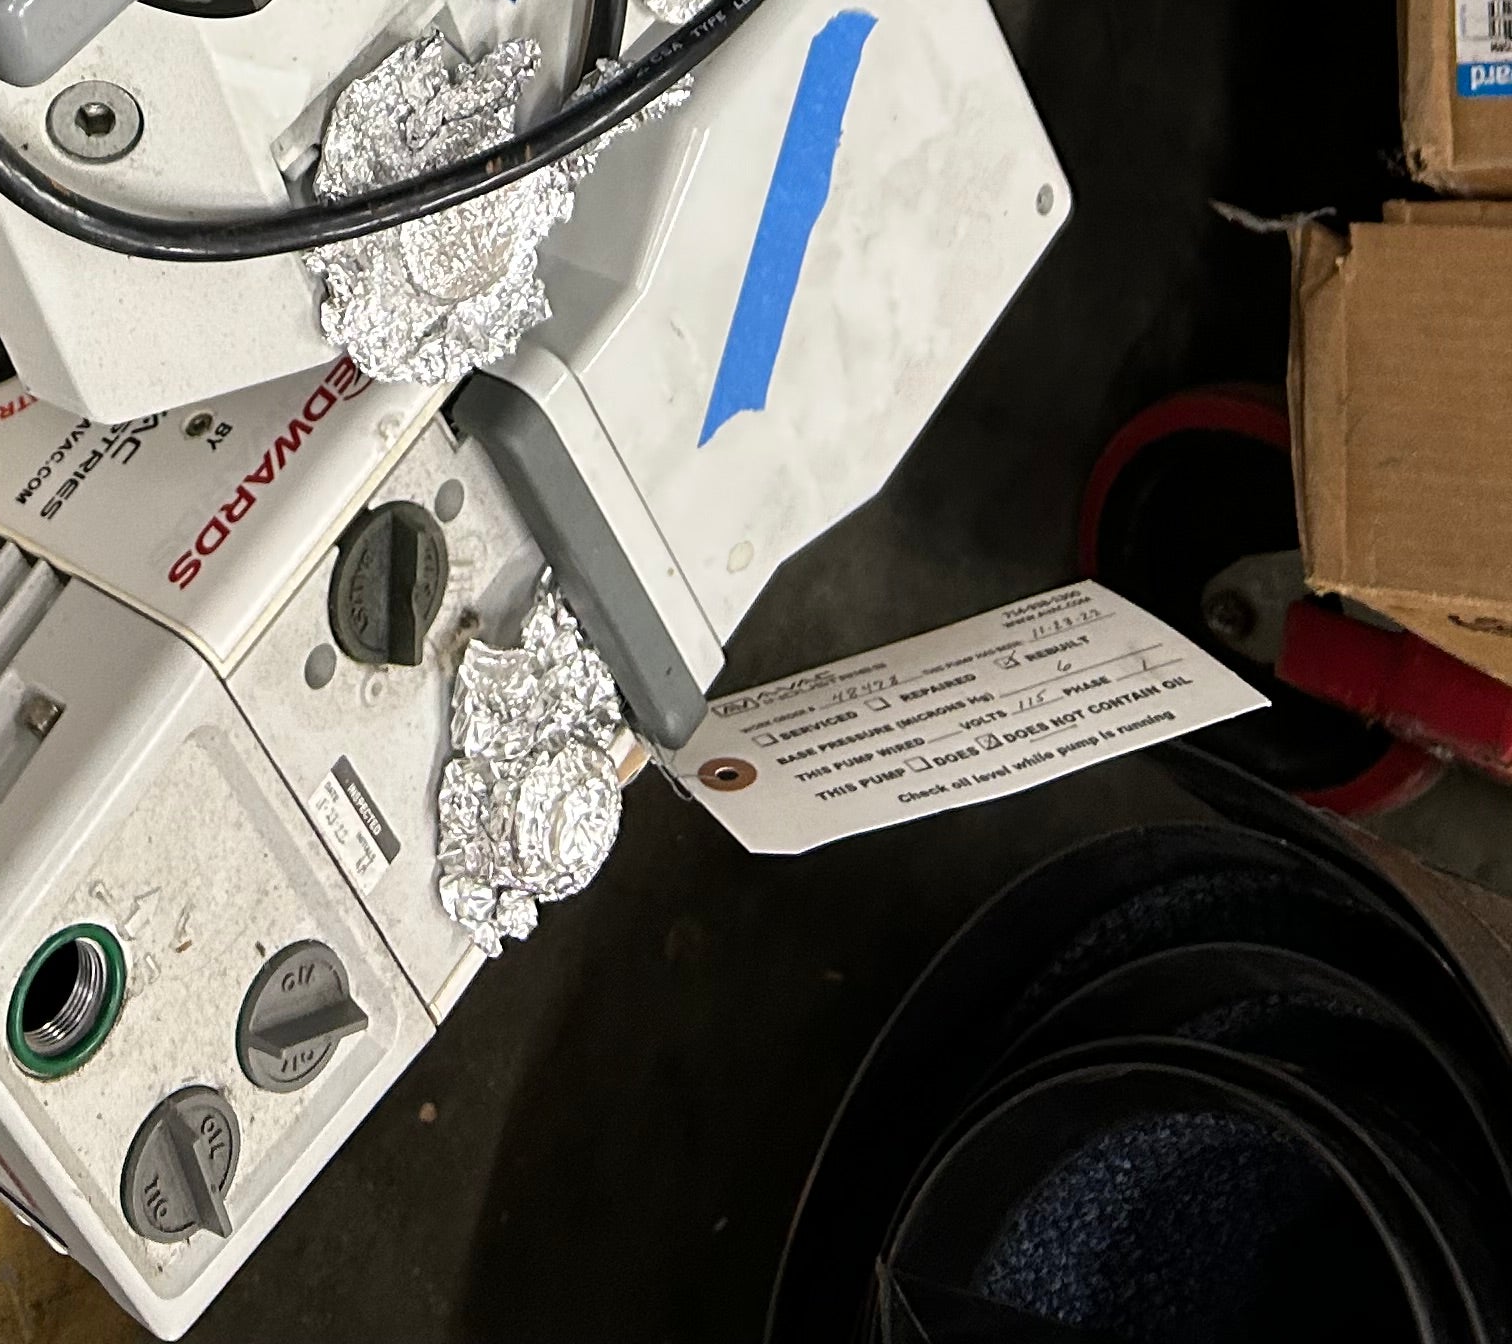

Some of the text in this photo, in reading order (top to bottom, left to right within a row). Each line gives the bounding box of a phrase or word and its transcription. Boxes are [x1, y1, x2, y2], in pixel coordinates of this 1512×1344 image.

[690, 8, 727, 40] TYPE
[168, 354, 372, 592] EDWARDS
[202, 418, 233, 454] BY
[777, 708, 858, 742] SERVICED
[899, 670, 977, 704] REPAIRED
[1024, 634, 1091, 663] REBUILT
[794, 763, 832, 784] THIS
[833, 749, 875, 772] PUMP
[876, 733, 926, 759] WIRED
[958, 707, 1008, 732] VOLTS
[1015, 687, 1049, 711] 115
[1061, 673, 1111, 698] PHASE
[776, 746, 817, 767] BASE
[818, 721, 894, 754] PRESSURE
[896, 698, 968, 729] (MICRONS
[814, 672, 1193, 803] THIS PUMP DOES DOES NOT CONTAIN OIL
[897, 779, 950, 807] Check
[949, 773, 973, 790] oil
[973, 760, 1011, 784] level
[1010, 747, 1055, 772] while
[1057, 733, 1101, 758] pump
[1116, 707, 1177, 735] running
[322, 780, 341, 803] DATE
[343, 782, 386, 836] INSPECTED
